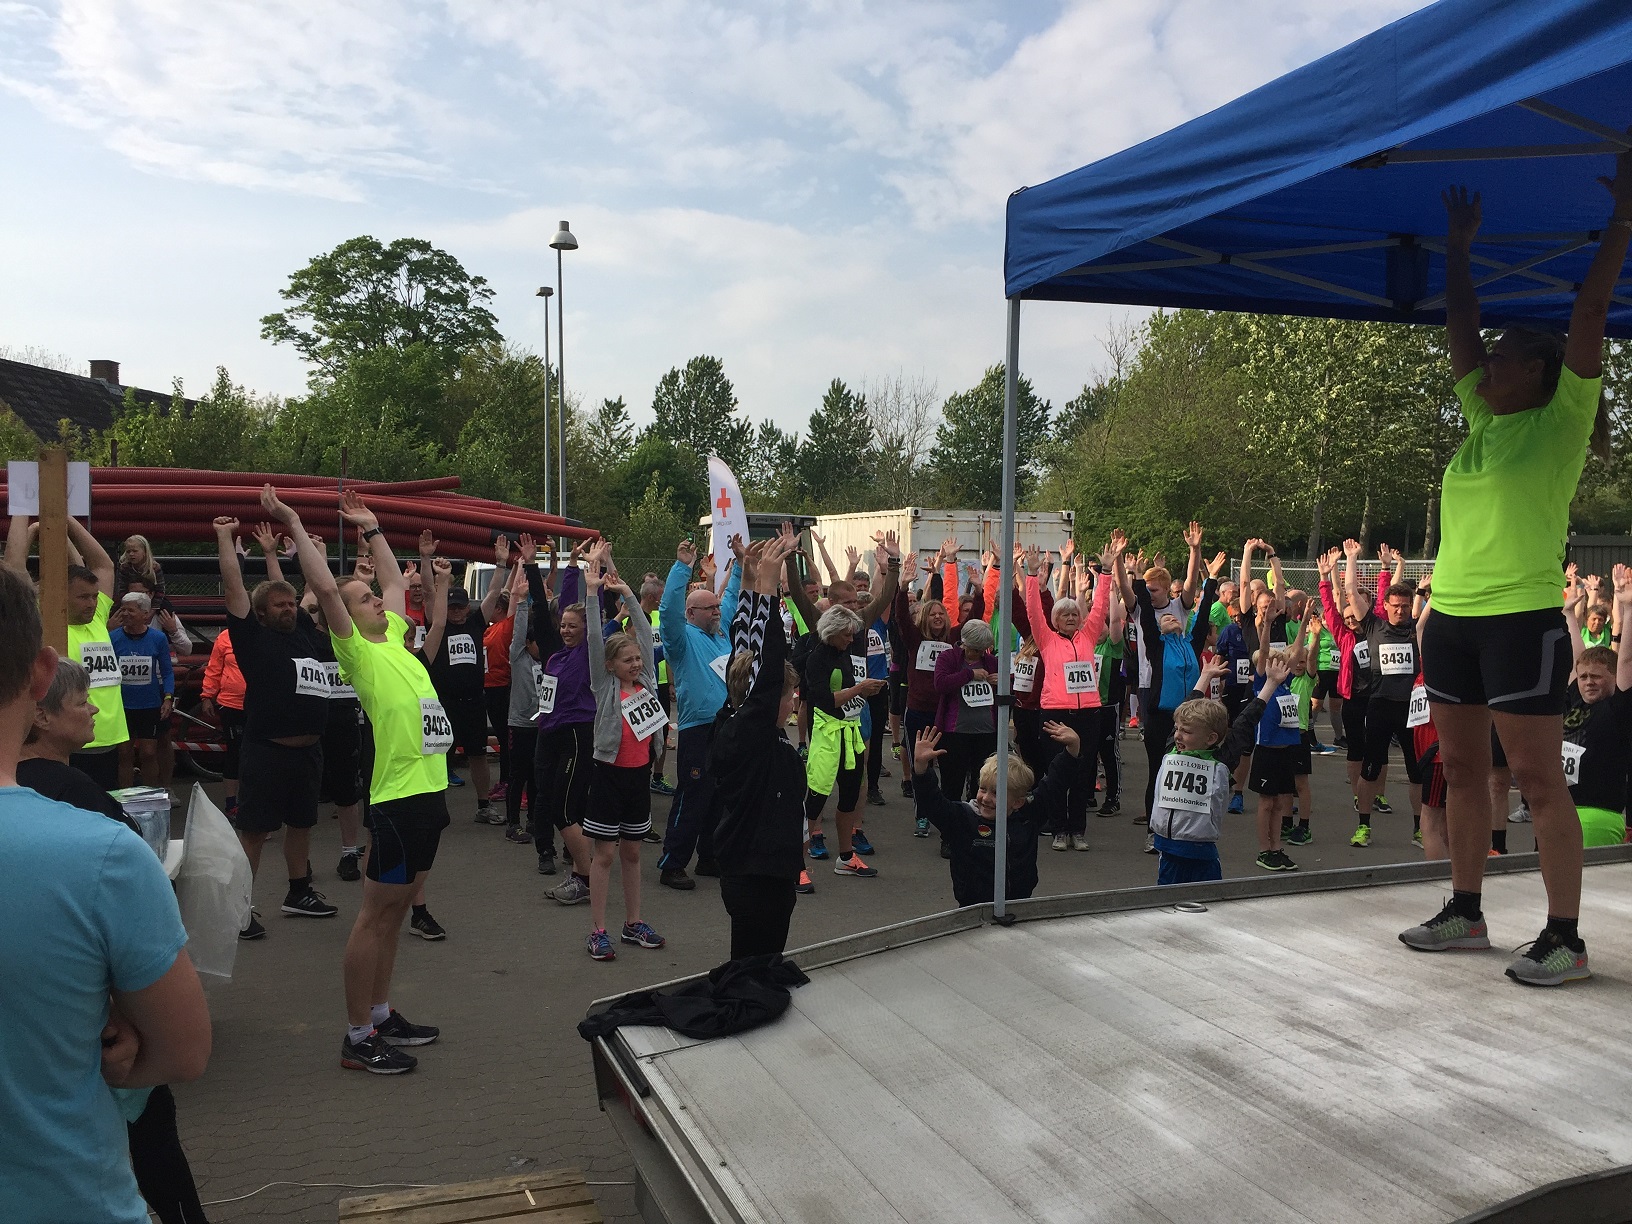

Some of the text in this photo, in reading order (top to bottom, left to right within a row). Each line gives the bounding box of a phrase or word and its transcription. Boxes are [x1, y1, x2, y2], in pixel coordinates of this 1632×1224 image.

[449, 642, 475, 655] 4684
[83, 655, 117, 674] 3443
[1381, 652, 1412, 665] 3434
[120, 664, 150, 676] 3412
[300, 666, 327, 686] 4741
[1068, 670, 1093, 683] 4761
[963, 684, 990, 697] 4760
[628, 697, 661, 726] 4736
[423, 714, 451, 736] 3423
[1163, 770, 1208, 796] 4743
[1260, 778, 1268, 788] 7
[1161, 795, 1208, 807] Handelsbanken
